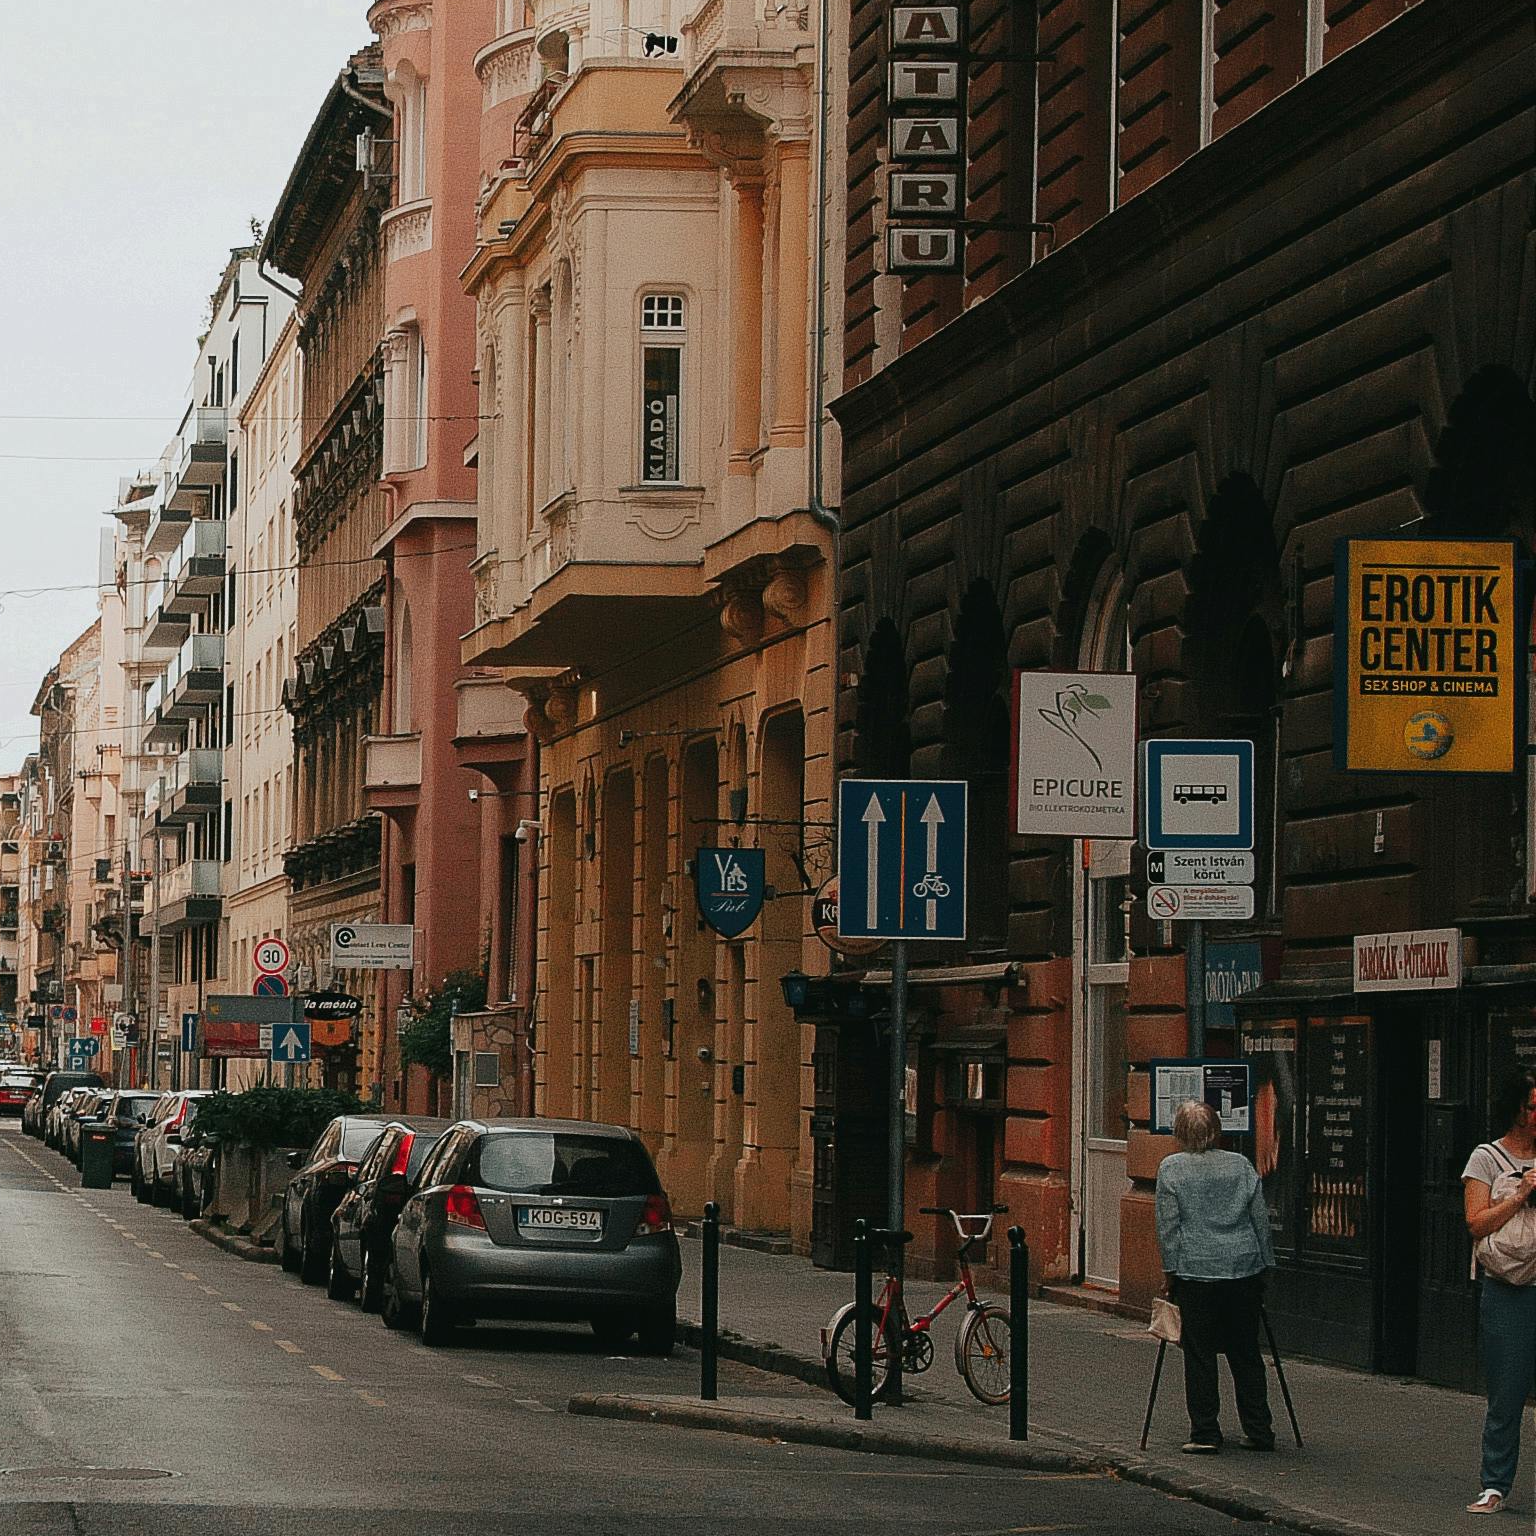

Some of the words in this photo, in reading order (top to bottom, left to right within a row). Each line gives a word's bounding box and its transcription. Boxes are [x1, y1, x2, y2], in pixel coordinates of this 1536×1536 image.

[646, 399, 665, 480] KIADÓ
[1361, 574, 1500, 624] EROTIK
[1360, 626, 1498, 673] CENTER
[1364, 680, 1388, 691] SEX
[1392, 680, 1426, 692] SHOP
[1430, 681, 1439, 692] &
[1443, 681, 1493, 693] CINEMA
[1033, 778, 1123, 798] EPICURE
[1150, 862, 1163, 873] M
[1174, 855, 1206, 867] Szent
[1210, 855, 1245, 867] István
[1193, 868, 1226, 880] körút
[263, 949, 280, 964] 30
[72, 1057, 82, 1070] P
[531, 1211, 596, 1226] KDG-594
